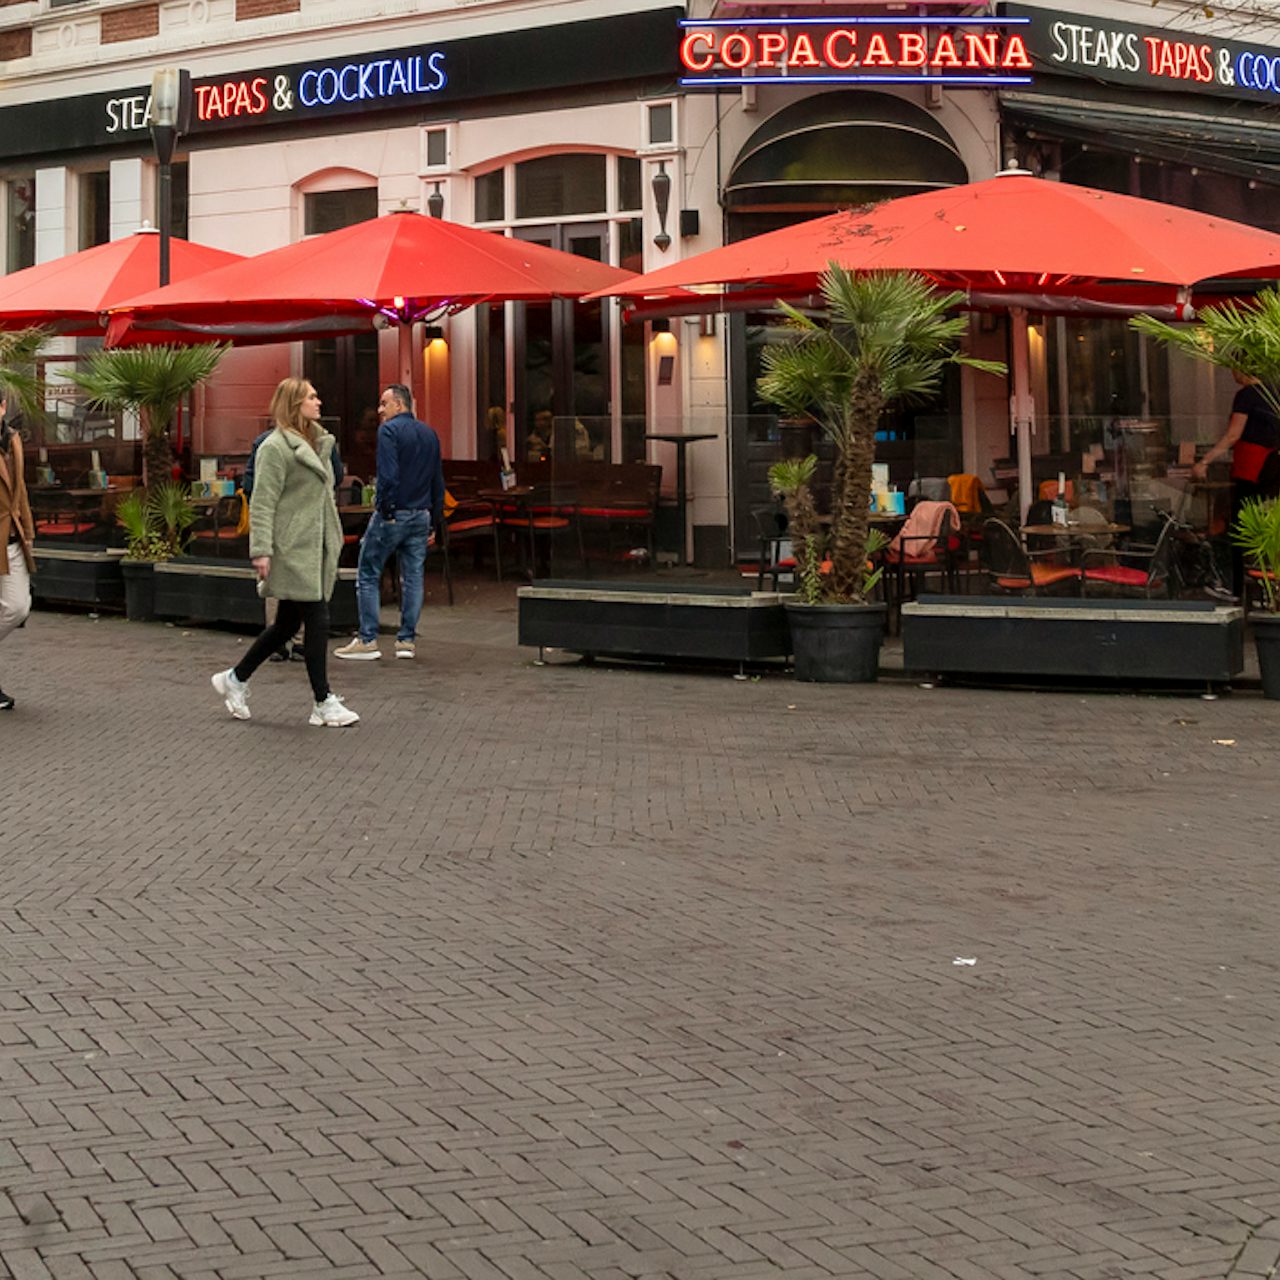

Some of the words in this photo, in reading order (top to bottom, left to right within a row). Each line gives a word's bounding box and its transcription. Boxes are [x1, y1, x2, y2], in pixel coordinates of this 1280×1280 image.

[679, 28, 1034, 71] COPACABANA
[1050, 21, 1140, 73] STEAKS
[1143, 37, 1215, 84] TAPAS
[1218, 48, 1236, 87] &
[106, 95, 154, 133] STEA
[194, 77, 268, 121] TAPAS
[272, 74, 294, 112] &
[298, 51, 447, 108] COCKTAILS
